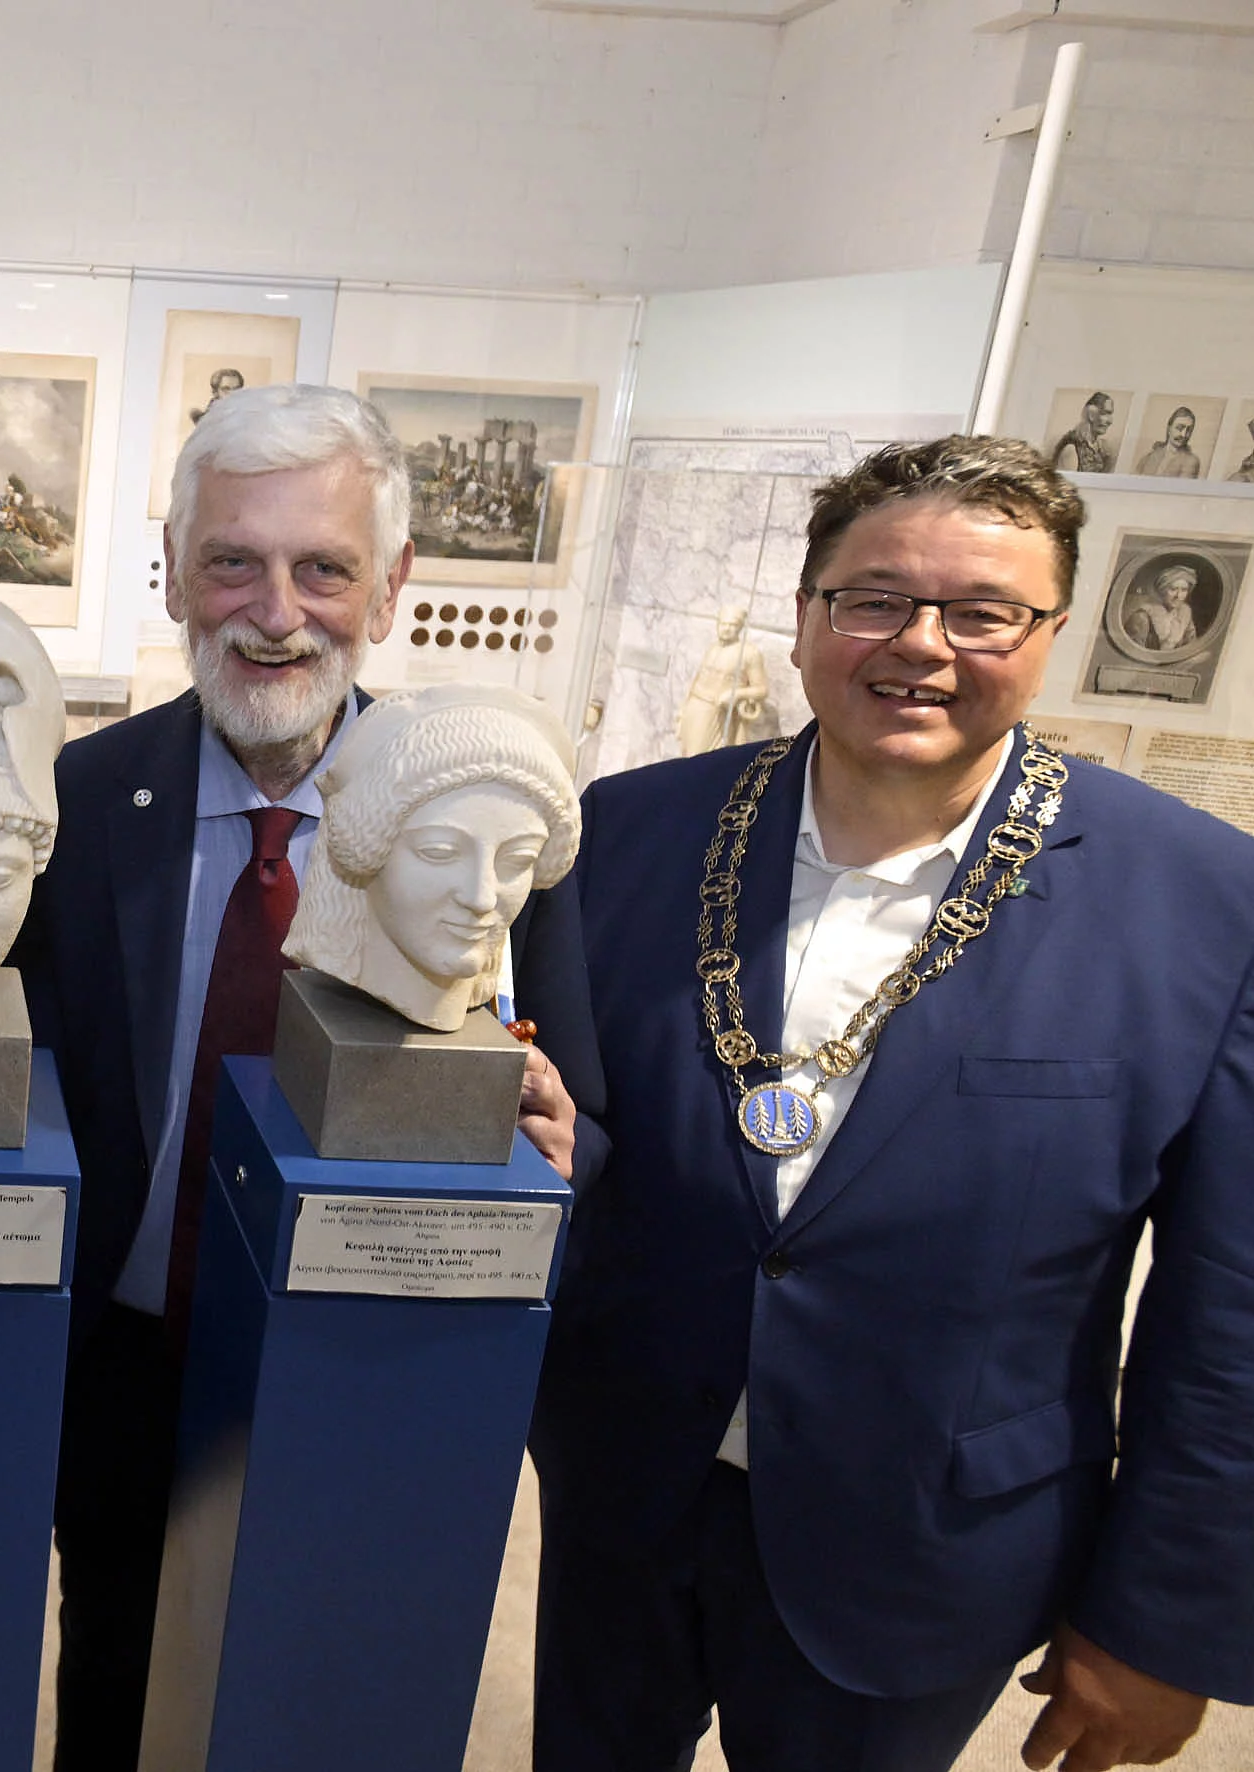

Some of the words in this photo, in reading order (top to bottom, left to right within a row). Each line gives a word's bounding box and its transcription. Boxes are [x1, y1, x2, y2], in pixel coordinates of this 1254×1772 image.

[324, 1203, 346, 1214] Kopf
[347, 1205, 370, 1214] einer
[373, 1206, 402, 1216] Sphinx
[404, 1208, 424, 1217] vom
[425, 1208, 449, 1218] Dach
[450, 1208, 466, 1218] des
[467, 1209, 534, 1222] Aphaia-Tempels
[319, 1217, 337, 1226] von
[345, 1240, 385, 1253] Κεφαλή
[430, 1247, 450, 1256] από
[370, 1254, 387, 1263] του
[417, 1258, 435, 1268] της
